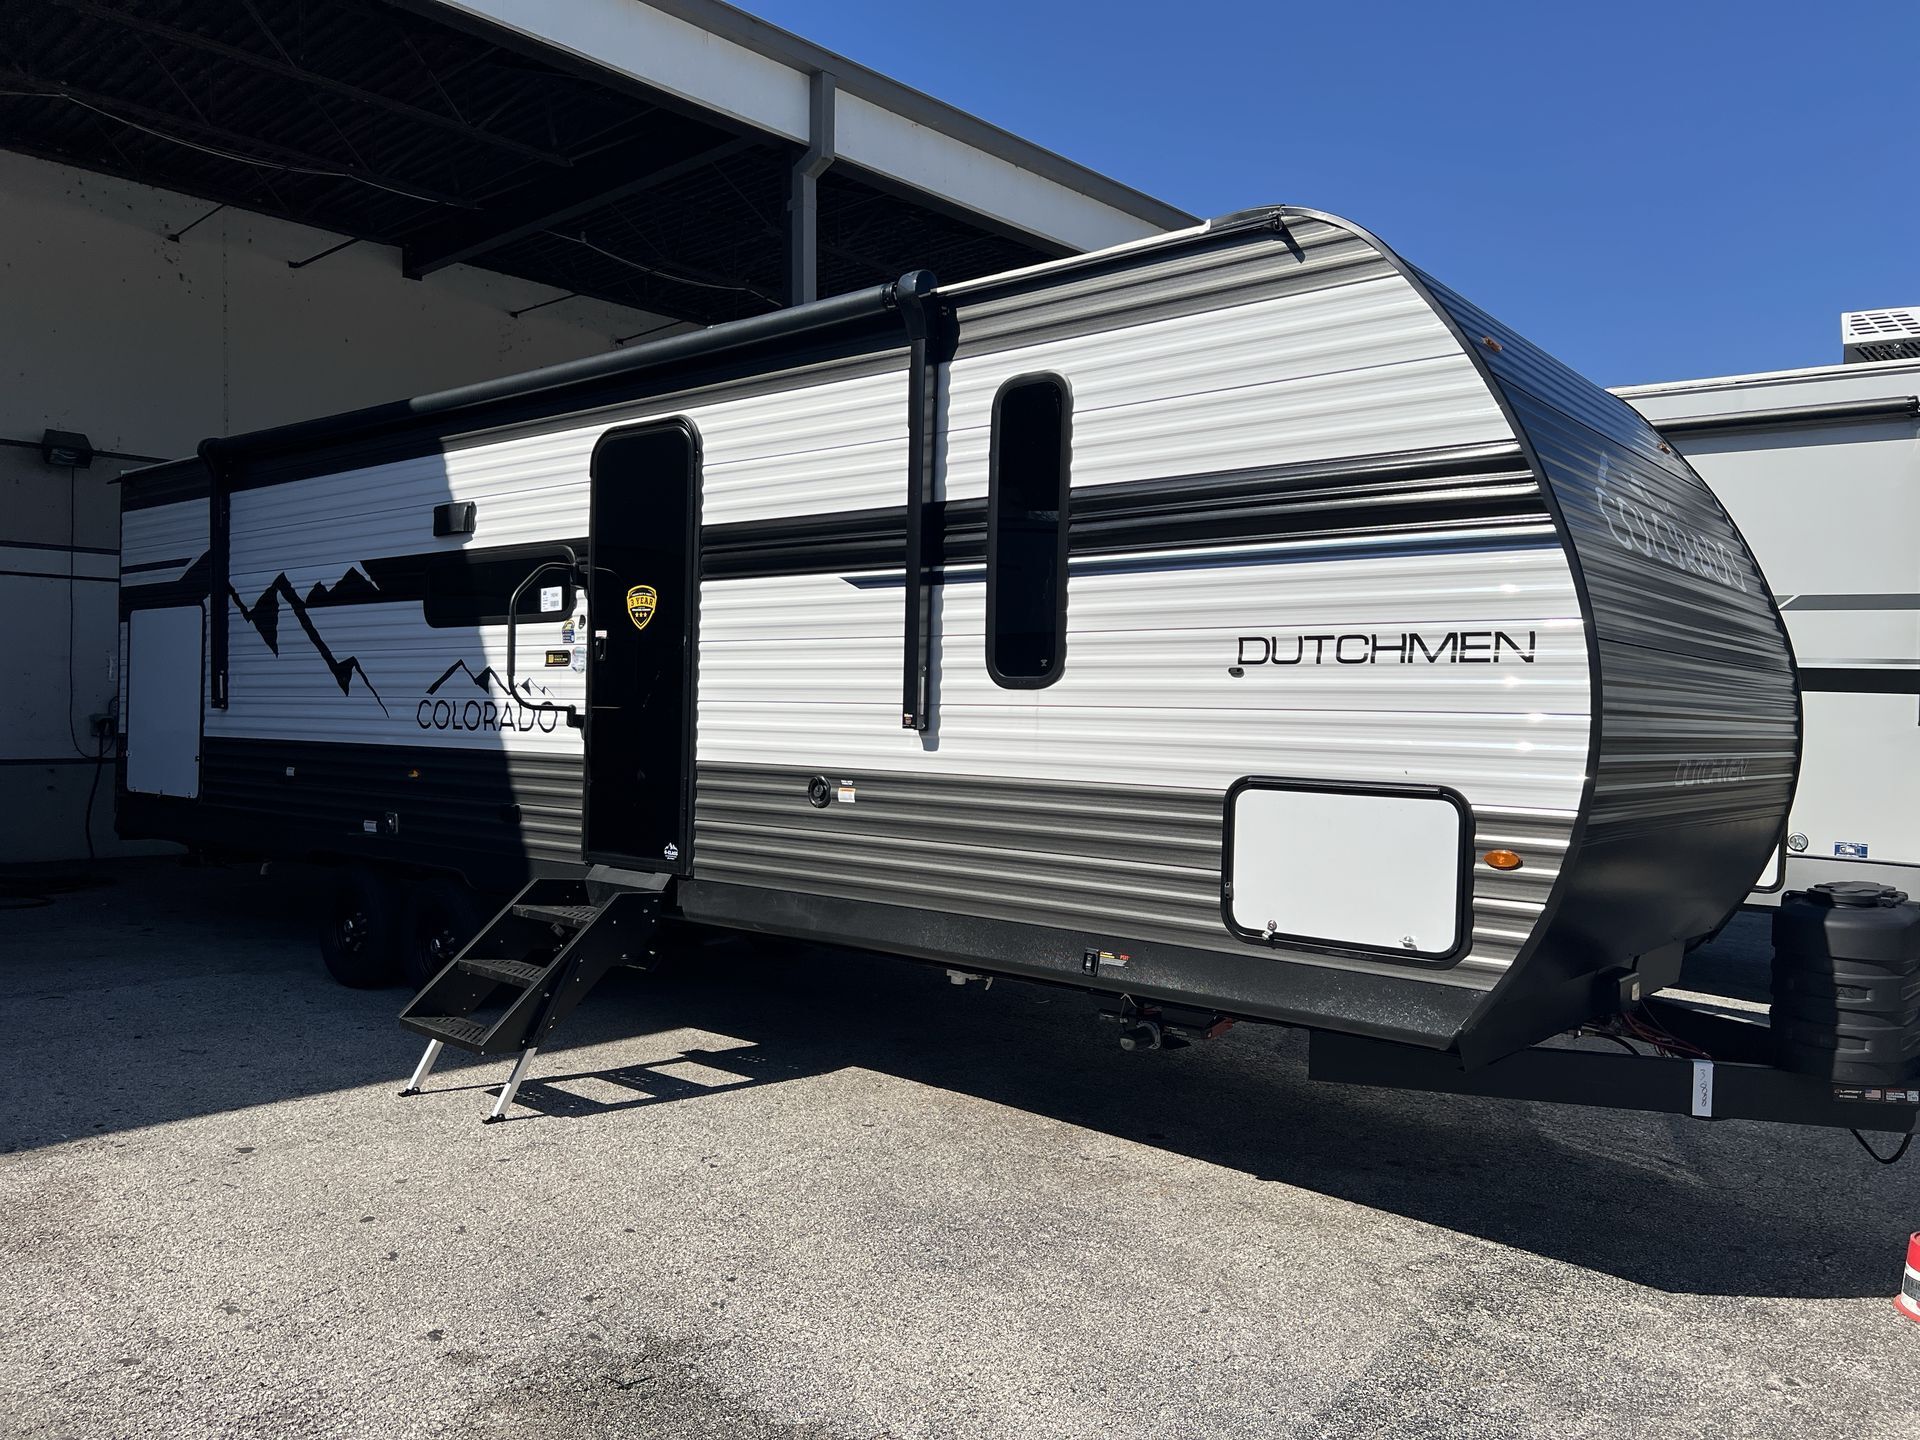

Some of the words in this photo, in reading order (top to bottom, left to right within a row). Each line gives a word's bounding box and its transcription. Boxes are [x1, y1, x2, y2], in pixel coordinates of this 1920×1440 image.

[1594, 486, 1747, 592] COLORADO
[636, 597, 654, 606] YEAR
[1238, 631, 1536, 665] DUTCHMEN
[416, 700, 558, 733] COLORADO
